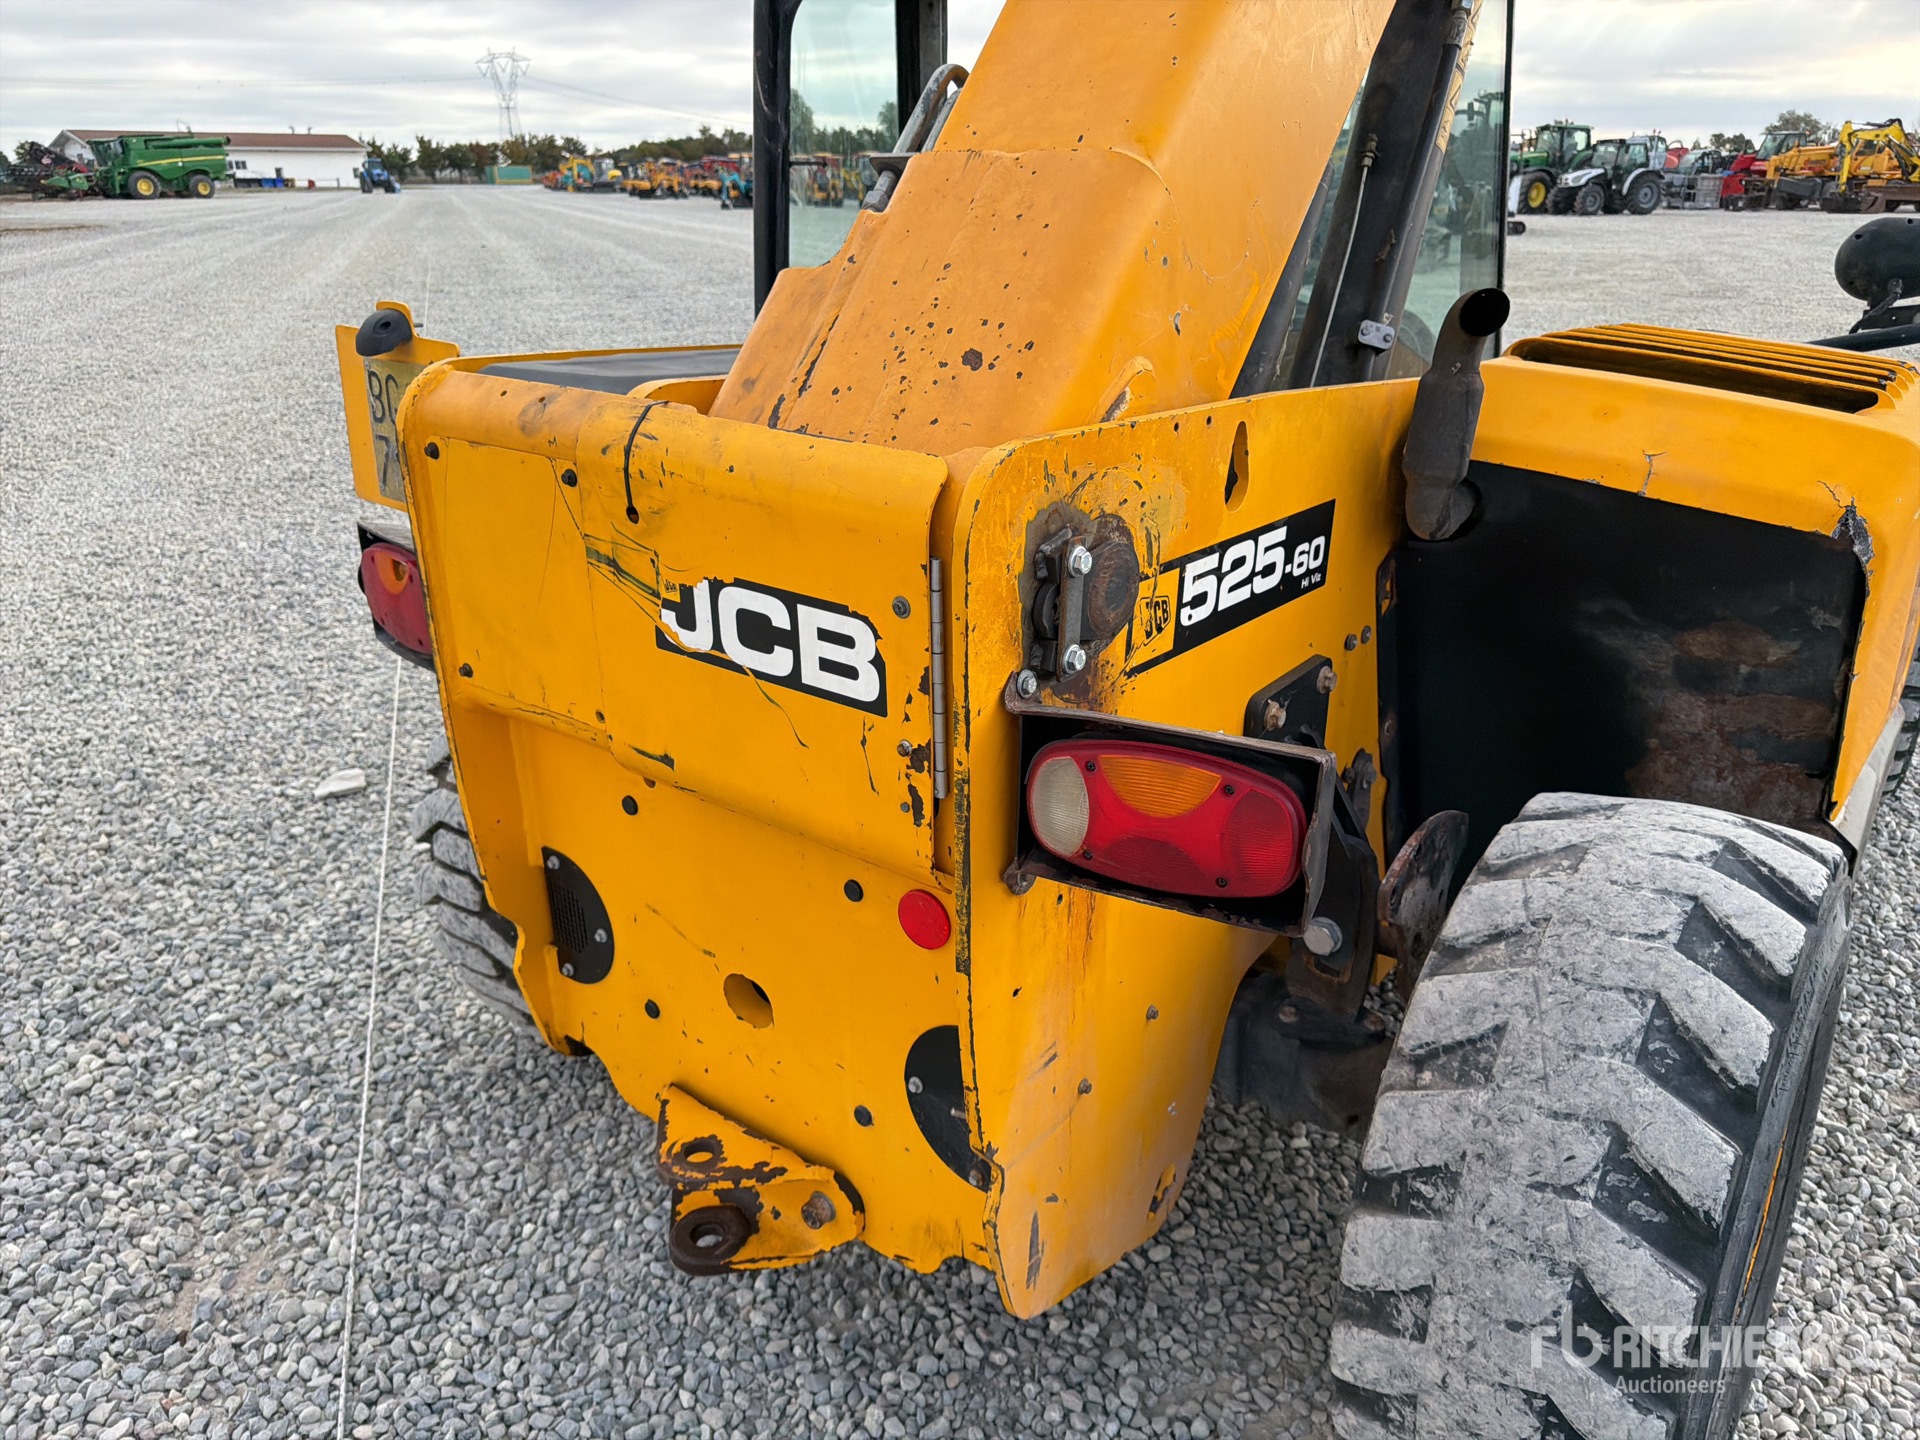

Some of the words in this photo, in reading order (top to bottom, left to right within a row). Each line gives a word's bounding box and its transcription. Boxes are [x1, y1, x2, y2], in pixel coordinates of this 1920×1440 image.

[1144, 599, 1169, 640] JCB
[1180, 525, 1326, 627] 525-60
[660, 578, 880, 702] JCB
